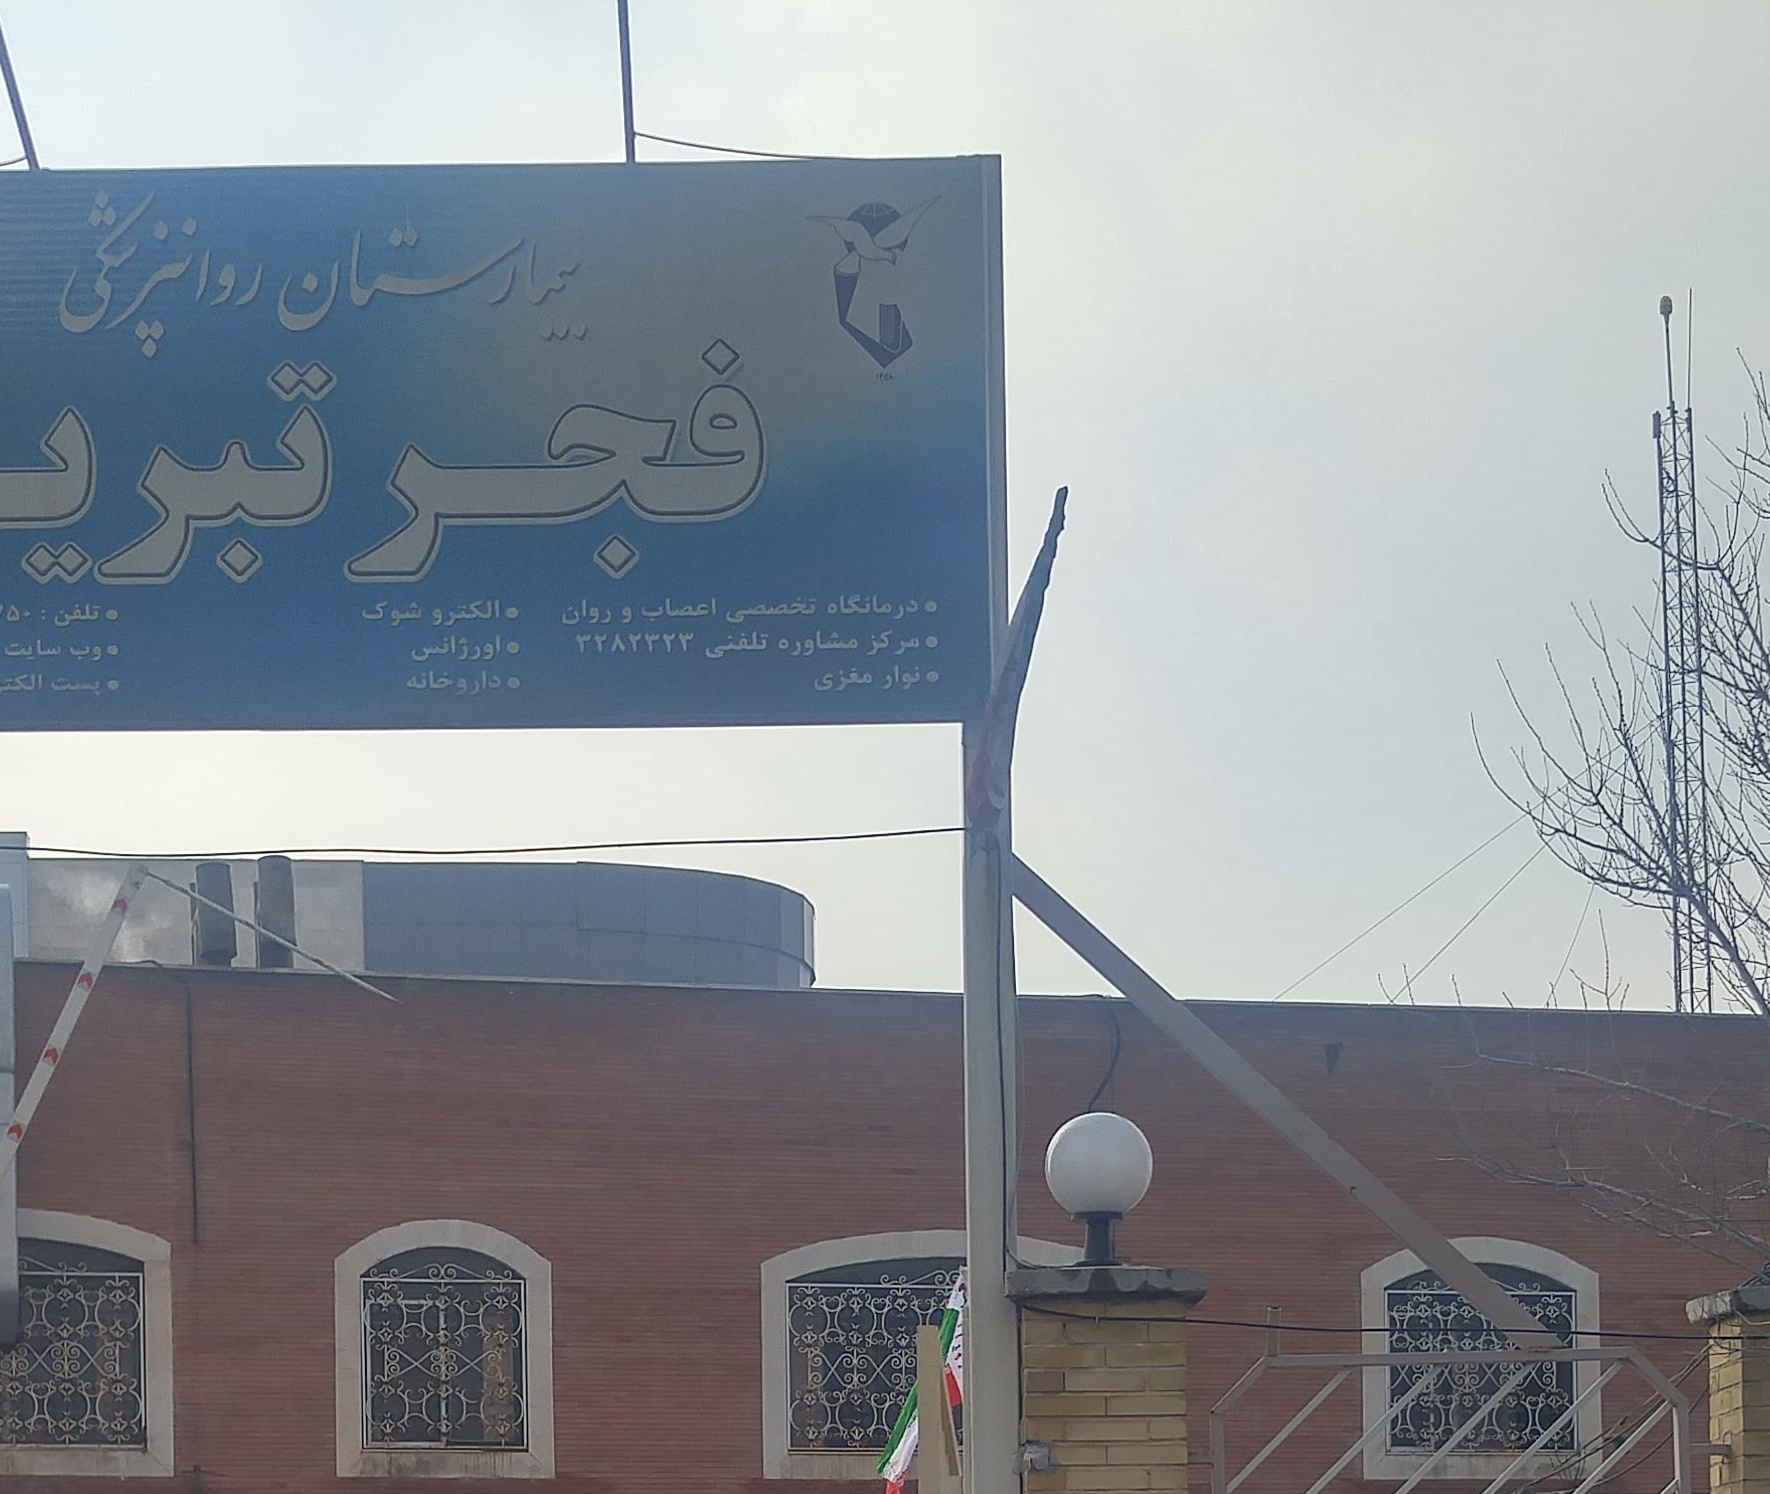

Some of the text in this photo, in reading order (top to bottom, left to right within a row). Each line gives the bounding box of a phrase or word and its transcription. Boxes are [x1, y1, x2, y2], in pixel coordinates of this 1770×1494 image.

[277, 225, 588, 342] بیمارستان
[343, 338, 768, 581] فجر
[54, 603, 101, 626] تلفن
[362, 599, 500, 626] الکترو شوک
[561, 594, 919, 624] درمانگاه تخصصی اعصاب و روان
[4, 638, 61, 660] سایت
[70, 645, 102, 661] وب
[411, 634, 501, 661] اورژانس
[704, 630, 769, 658] تلفنی
[778, 630, 859, 656] مشاوره
[867, 630, 920, 655] مرکز
[50, 678, 101, 697] پست
[406, 670, 502, 695] داروخانه
[814, 664, 920, 691] نوار مغزی
